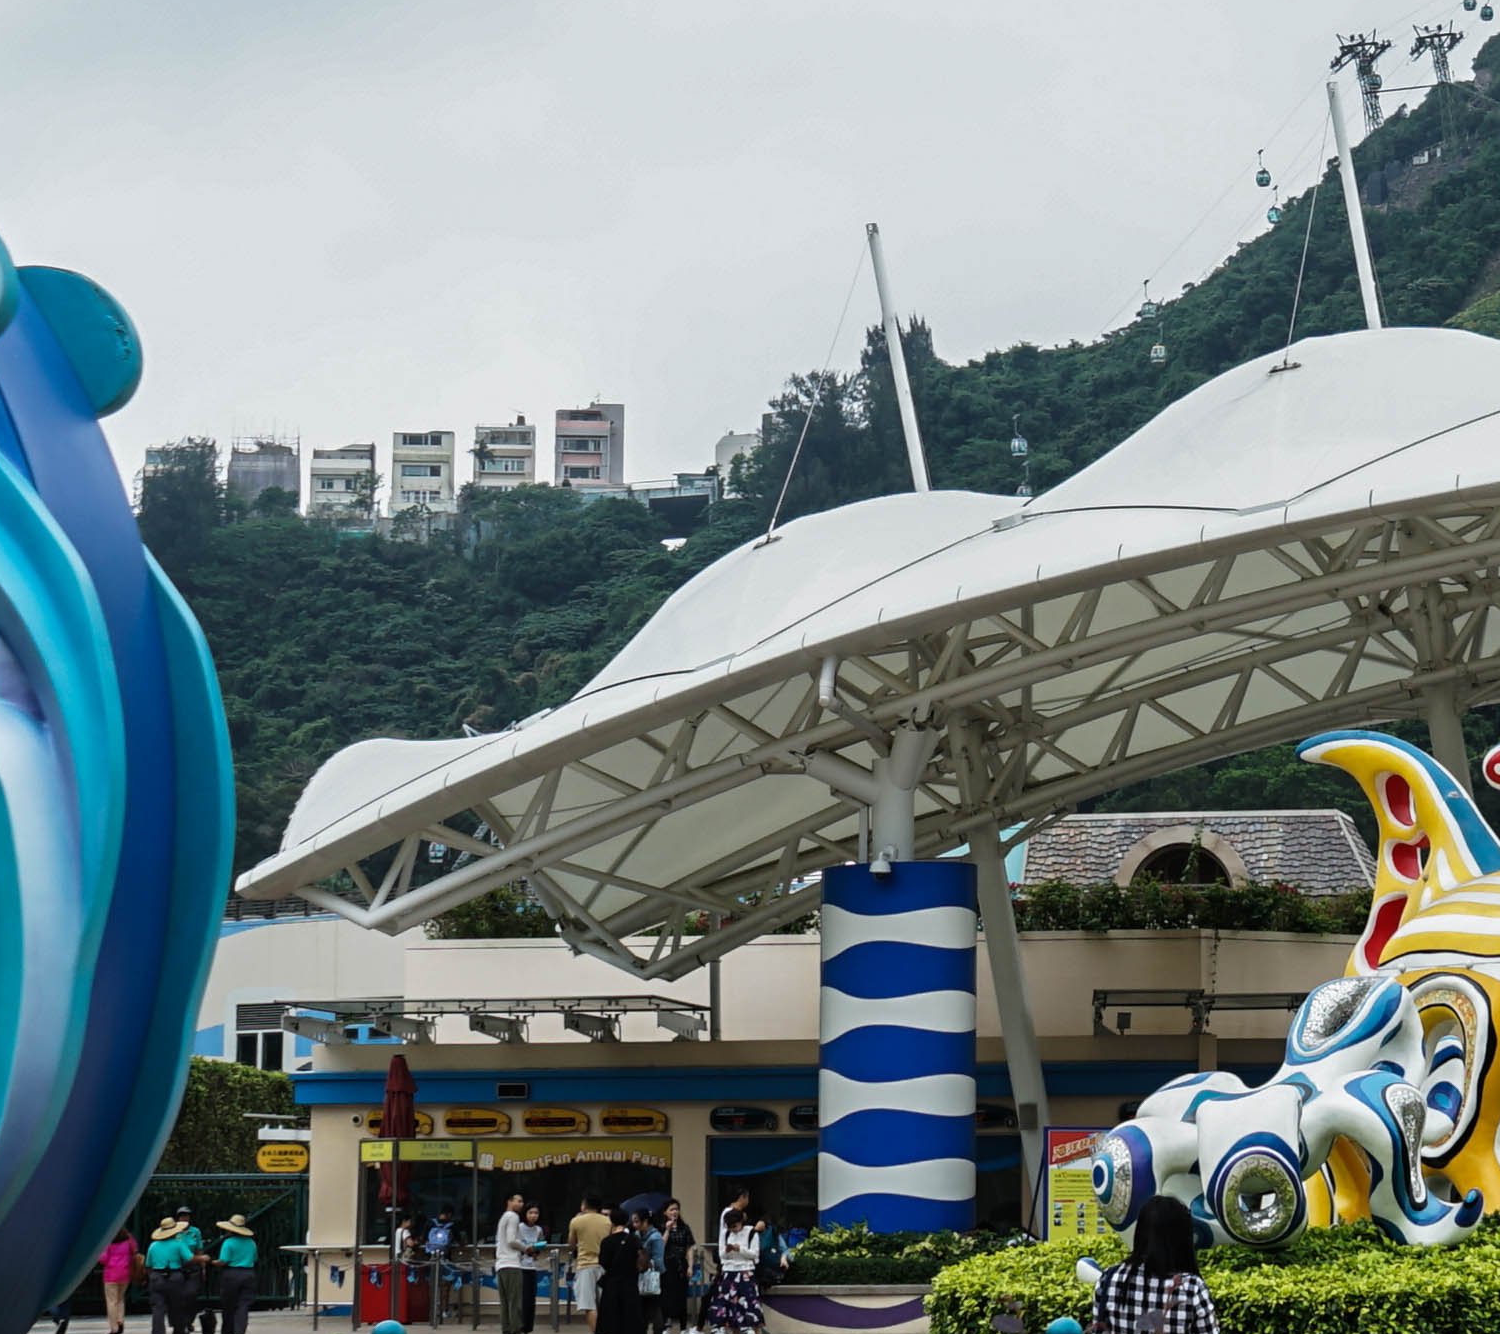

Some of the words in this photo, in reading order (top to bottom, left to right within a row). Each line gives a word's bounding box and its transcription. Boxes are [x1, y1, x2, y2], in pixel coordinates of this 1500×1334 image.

[502, 1151, 571, 1172] SmartFun
[575, 1150, 627, 1164] Annual
[632, 1151, 667, 1168] Pass
